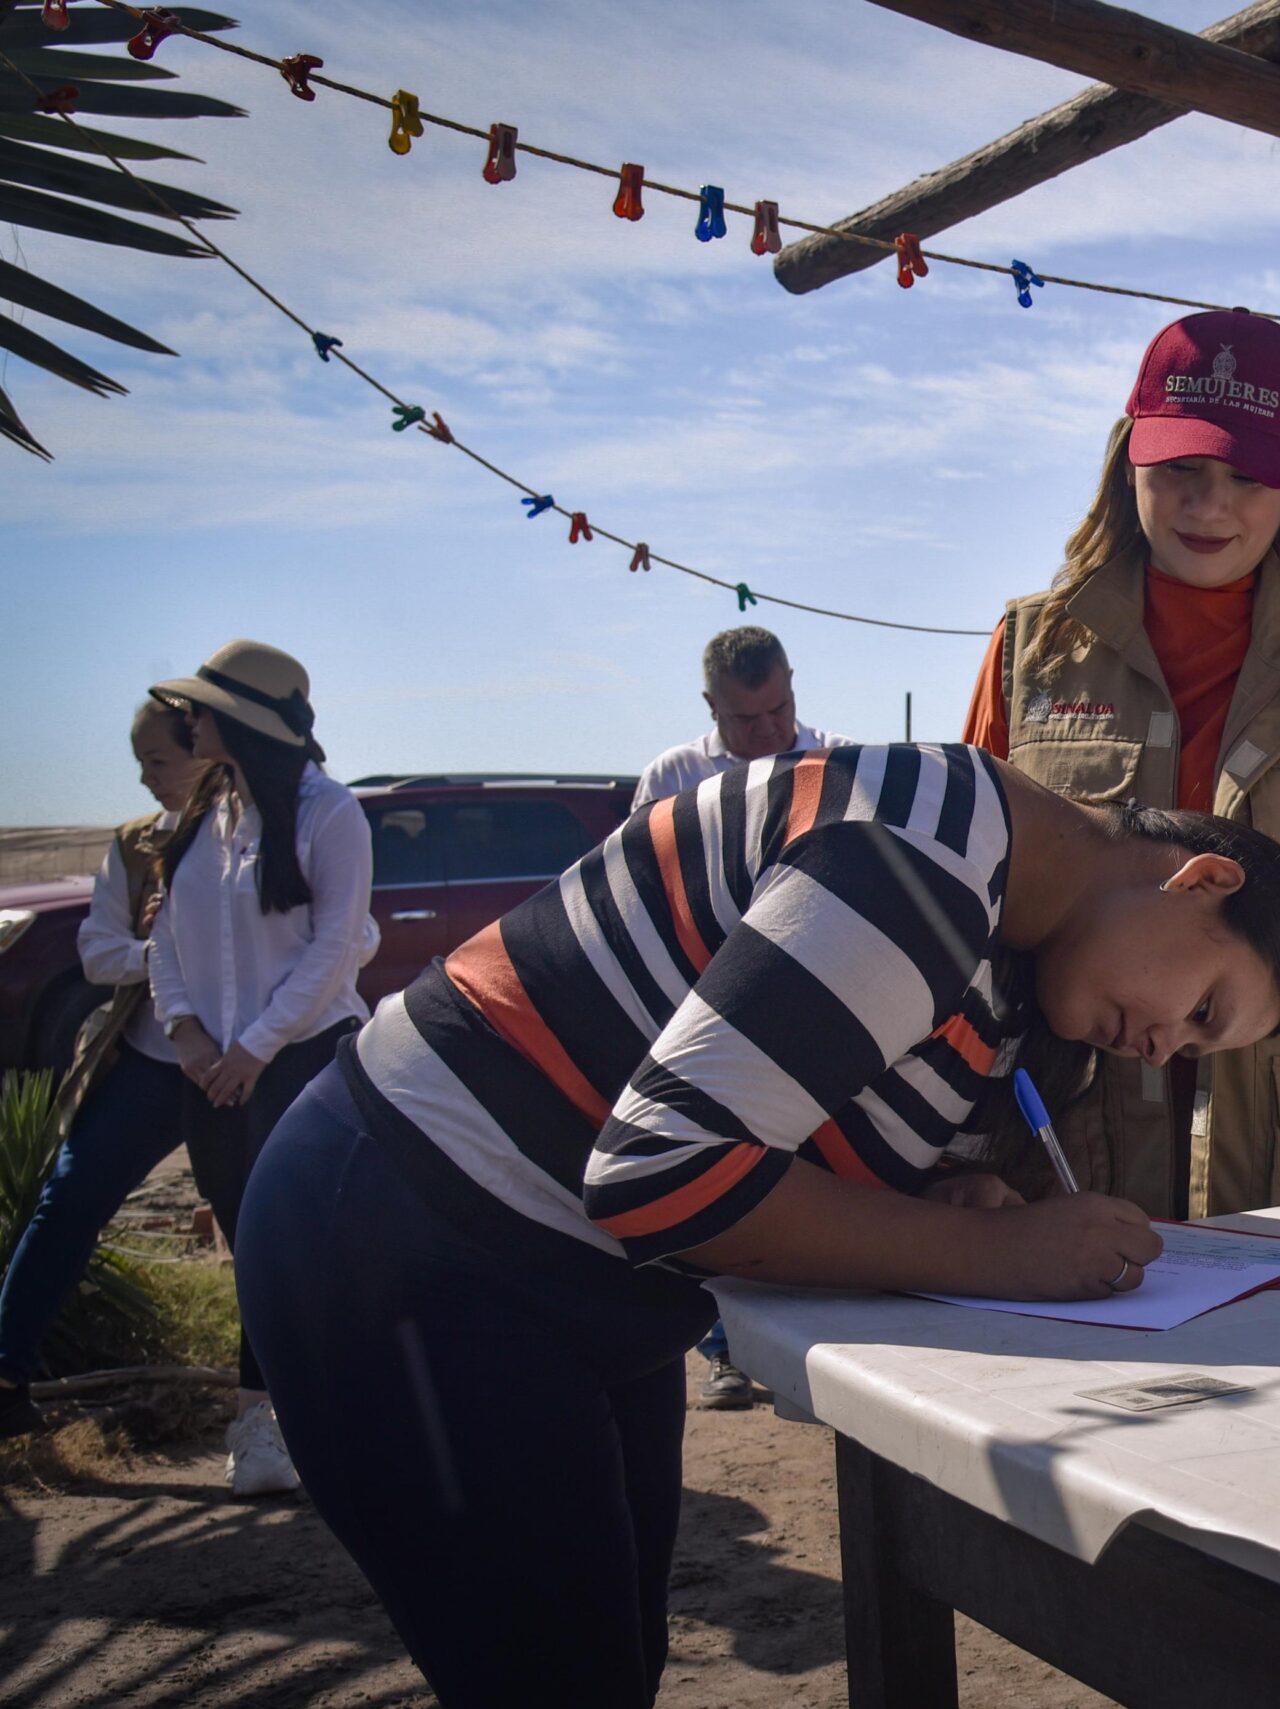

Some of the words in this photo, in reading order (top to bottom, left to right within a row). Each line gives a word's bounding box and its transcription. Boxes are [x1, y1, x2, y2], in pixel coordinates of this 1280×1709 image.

[1165, 375, 1280, 408] SEMUJERES
[1165, 395, 1206, 404] SECRETARÍA
[1223, 399, 1240, 408] LAS
[1243, 404, 1275, 418] MUJERES
[1052, 703, 1115, 714] SINALOA
